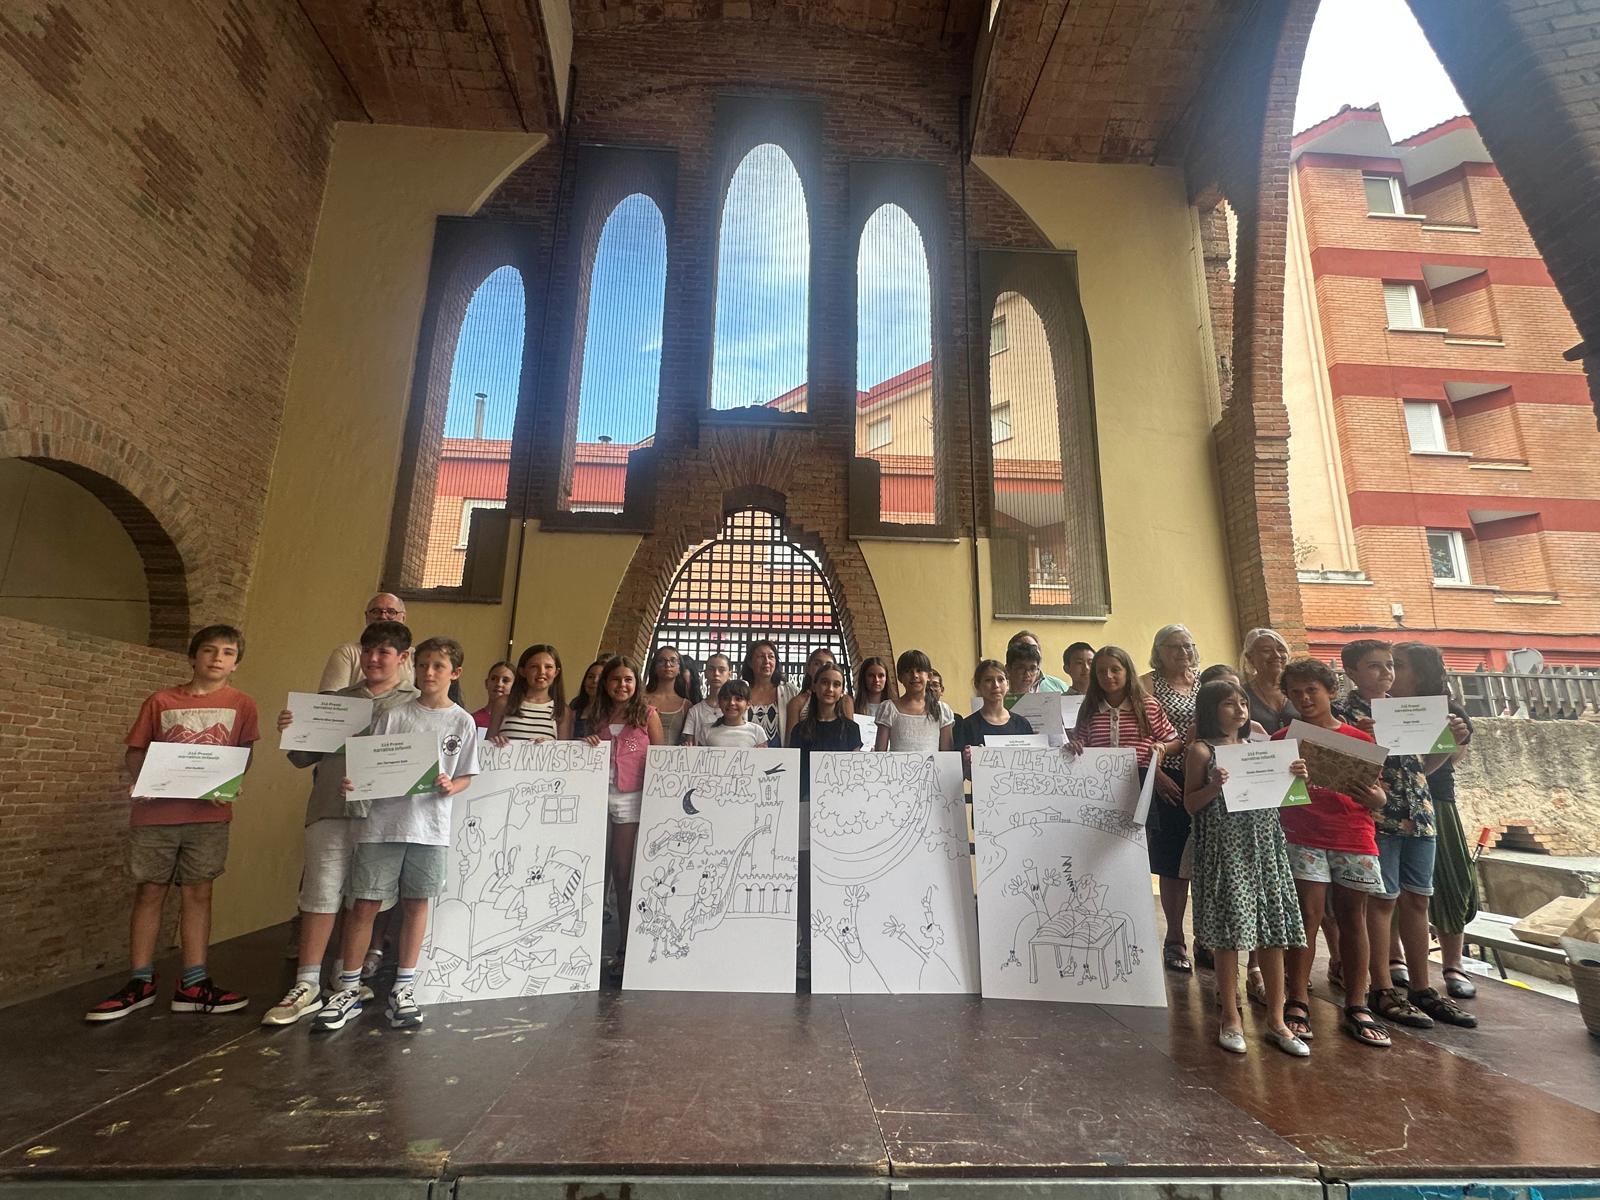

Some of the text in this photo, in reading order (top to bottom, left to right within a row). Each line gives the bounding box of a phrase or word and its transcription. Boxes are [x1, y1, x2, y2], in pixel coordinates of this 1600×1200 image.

[649, 748, 755, 776] UNA NIT AL
[815, 752, 923, 787] AFEBLITS
[979, 750, 1006, 769] LA
[1095, 753, 1135, 780] QUE
[646, 773, 752, 799] MONESTIR
